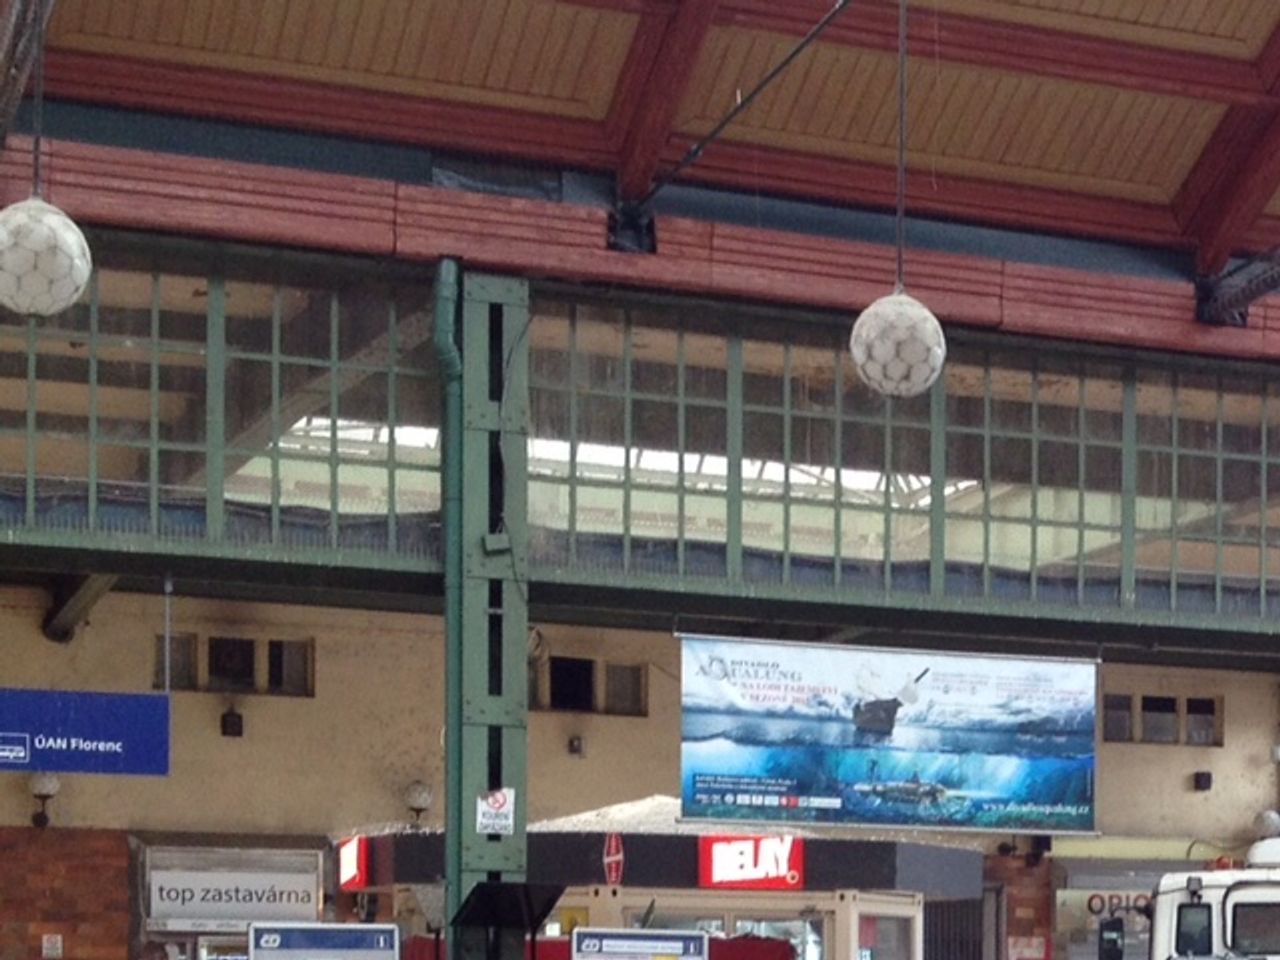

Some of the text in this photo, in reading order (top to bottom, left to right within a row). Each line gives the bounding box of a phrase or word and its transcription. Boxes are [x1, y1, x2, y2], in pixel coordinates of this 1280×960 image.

[34, 733, 123, 753] ÚAN Florenc
[711, 834, 794, 884] RELAY
[158, 885, 312, 906] top zastavárna
